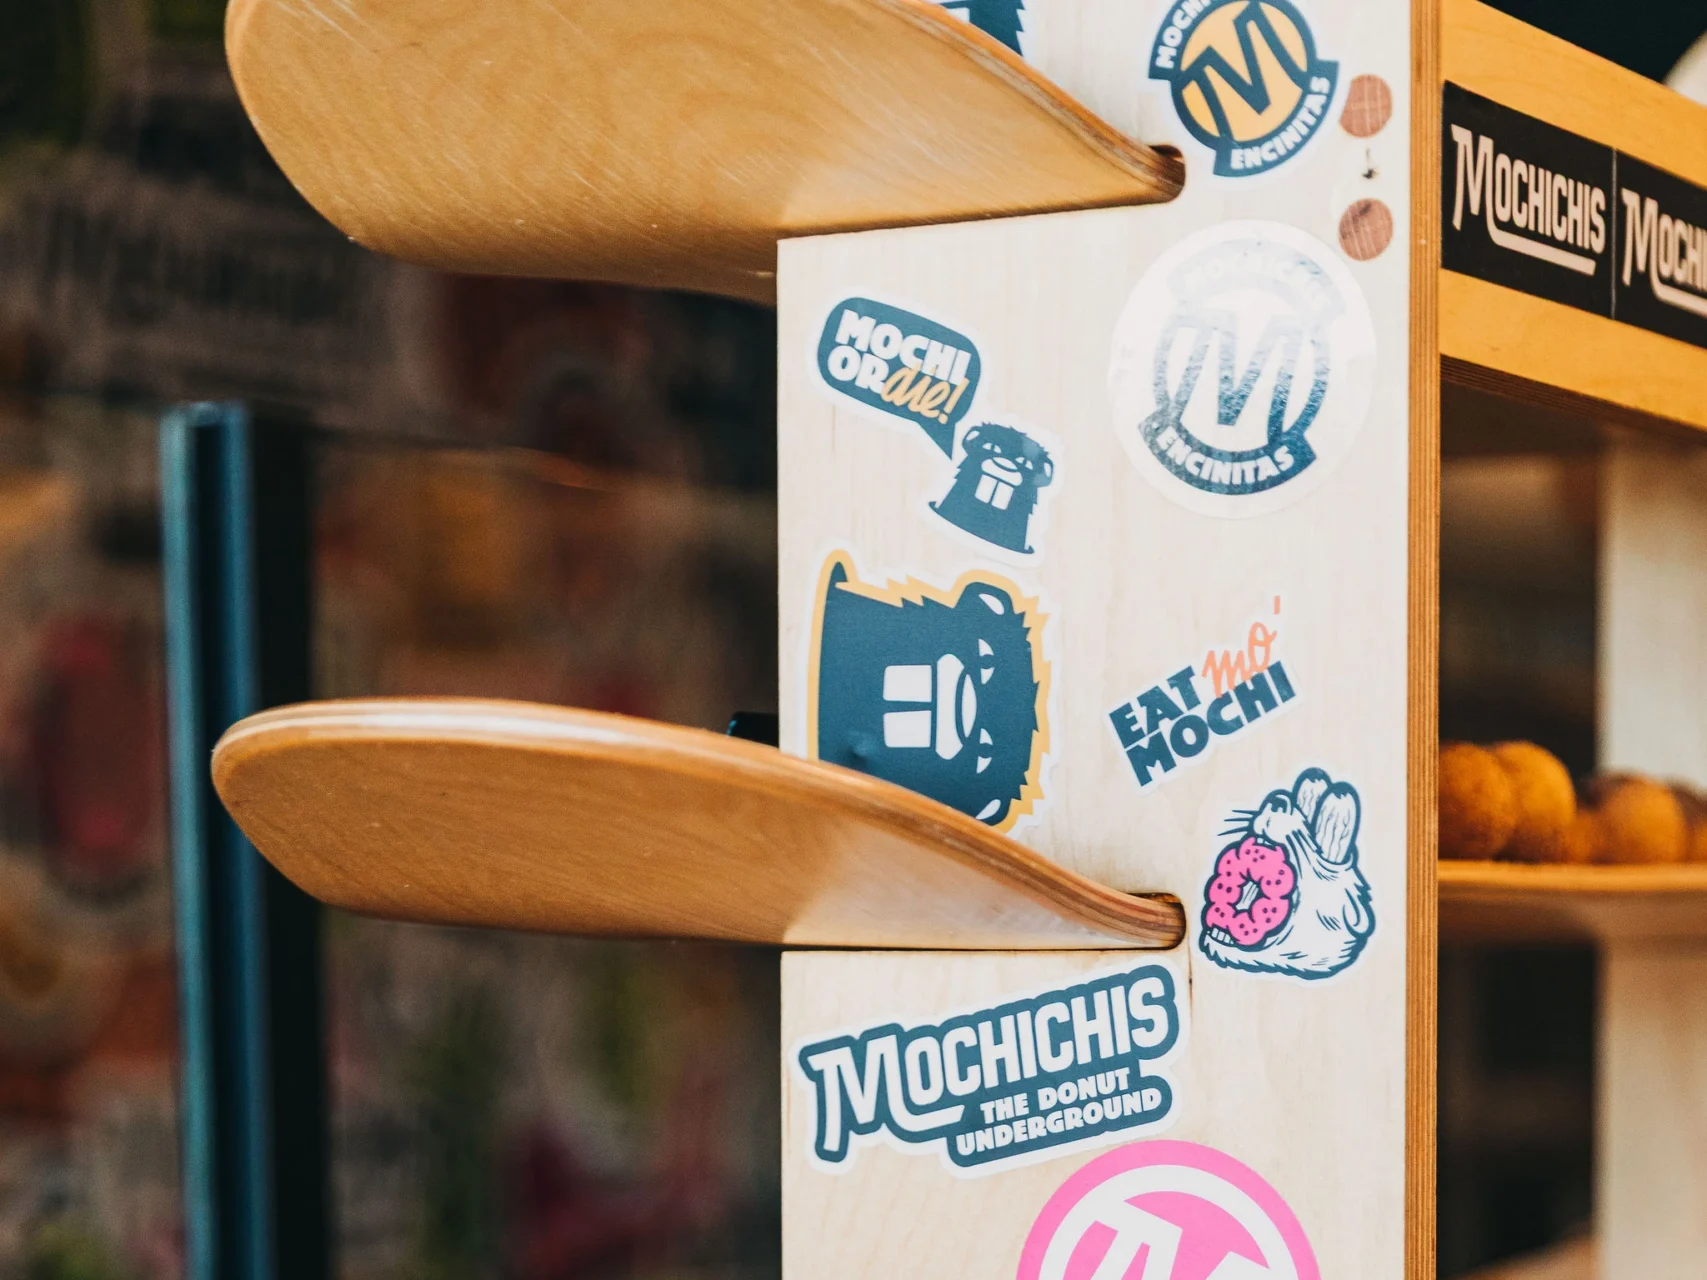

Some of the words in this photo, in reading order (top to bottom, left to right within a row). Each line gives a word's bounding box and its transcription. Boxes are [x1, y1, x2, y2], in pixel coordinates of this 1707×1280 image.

[1230, 76, 1331, 170] ENCINITAS
[1451, 123, 1606, 276] MOCHICHIS
[827, 344, 890, 395] OR
[880, 362, 970, 425] die!
[835, 309, 972, 386] MOCHI
[1155, 425, 1295, 485] ENCINITAS
[1108, 664, 1202, 749] EAT
[1125, 660, 1297, 788] MOCHI
[807, 976, 1170, 1153] MOCHICHIS
[980, 1093, 1029, 1125] THE
[1038, 1067, 1130, 1112] DONUT
[956, 1087, 1162, 1157] UNDERGROUND
